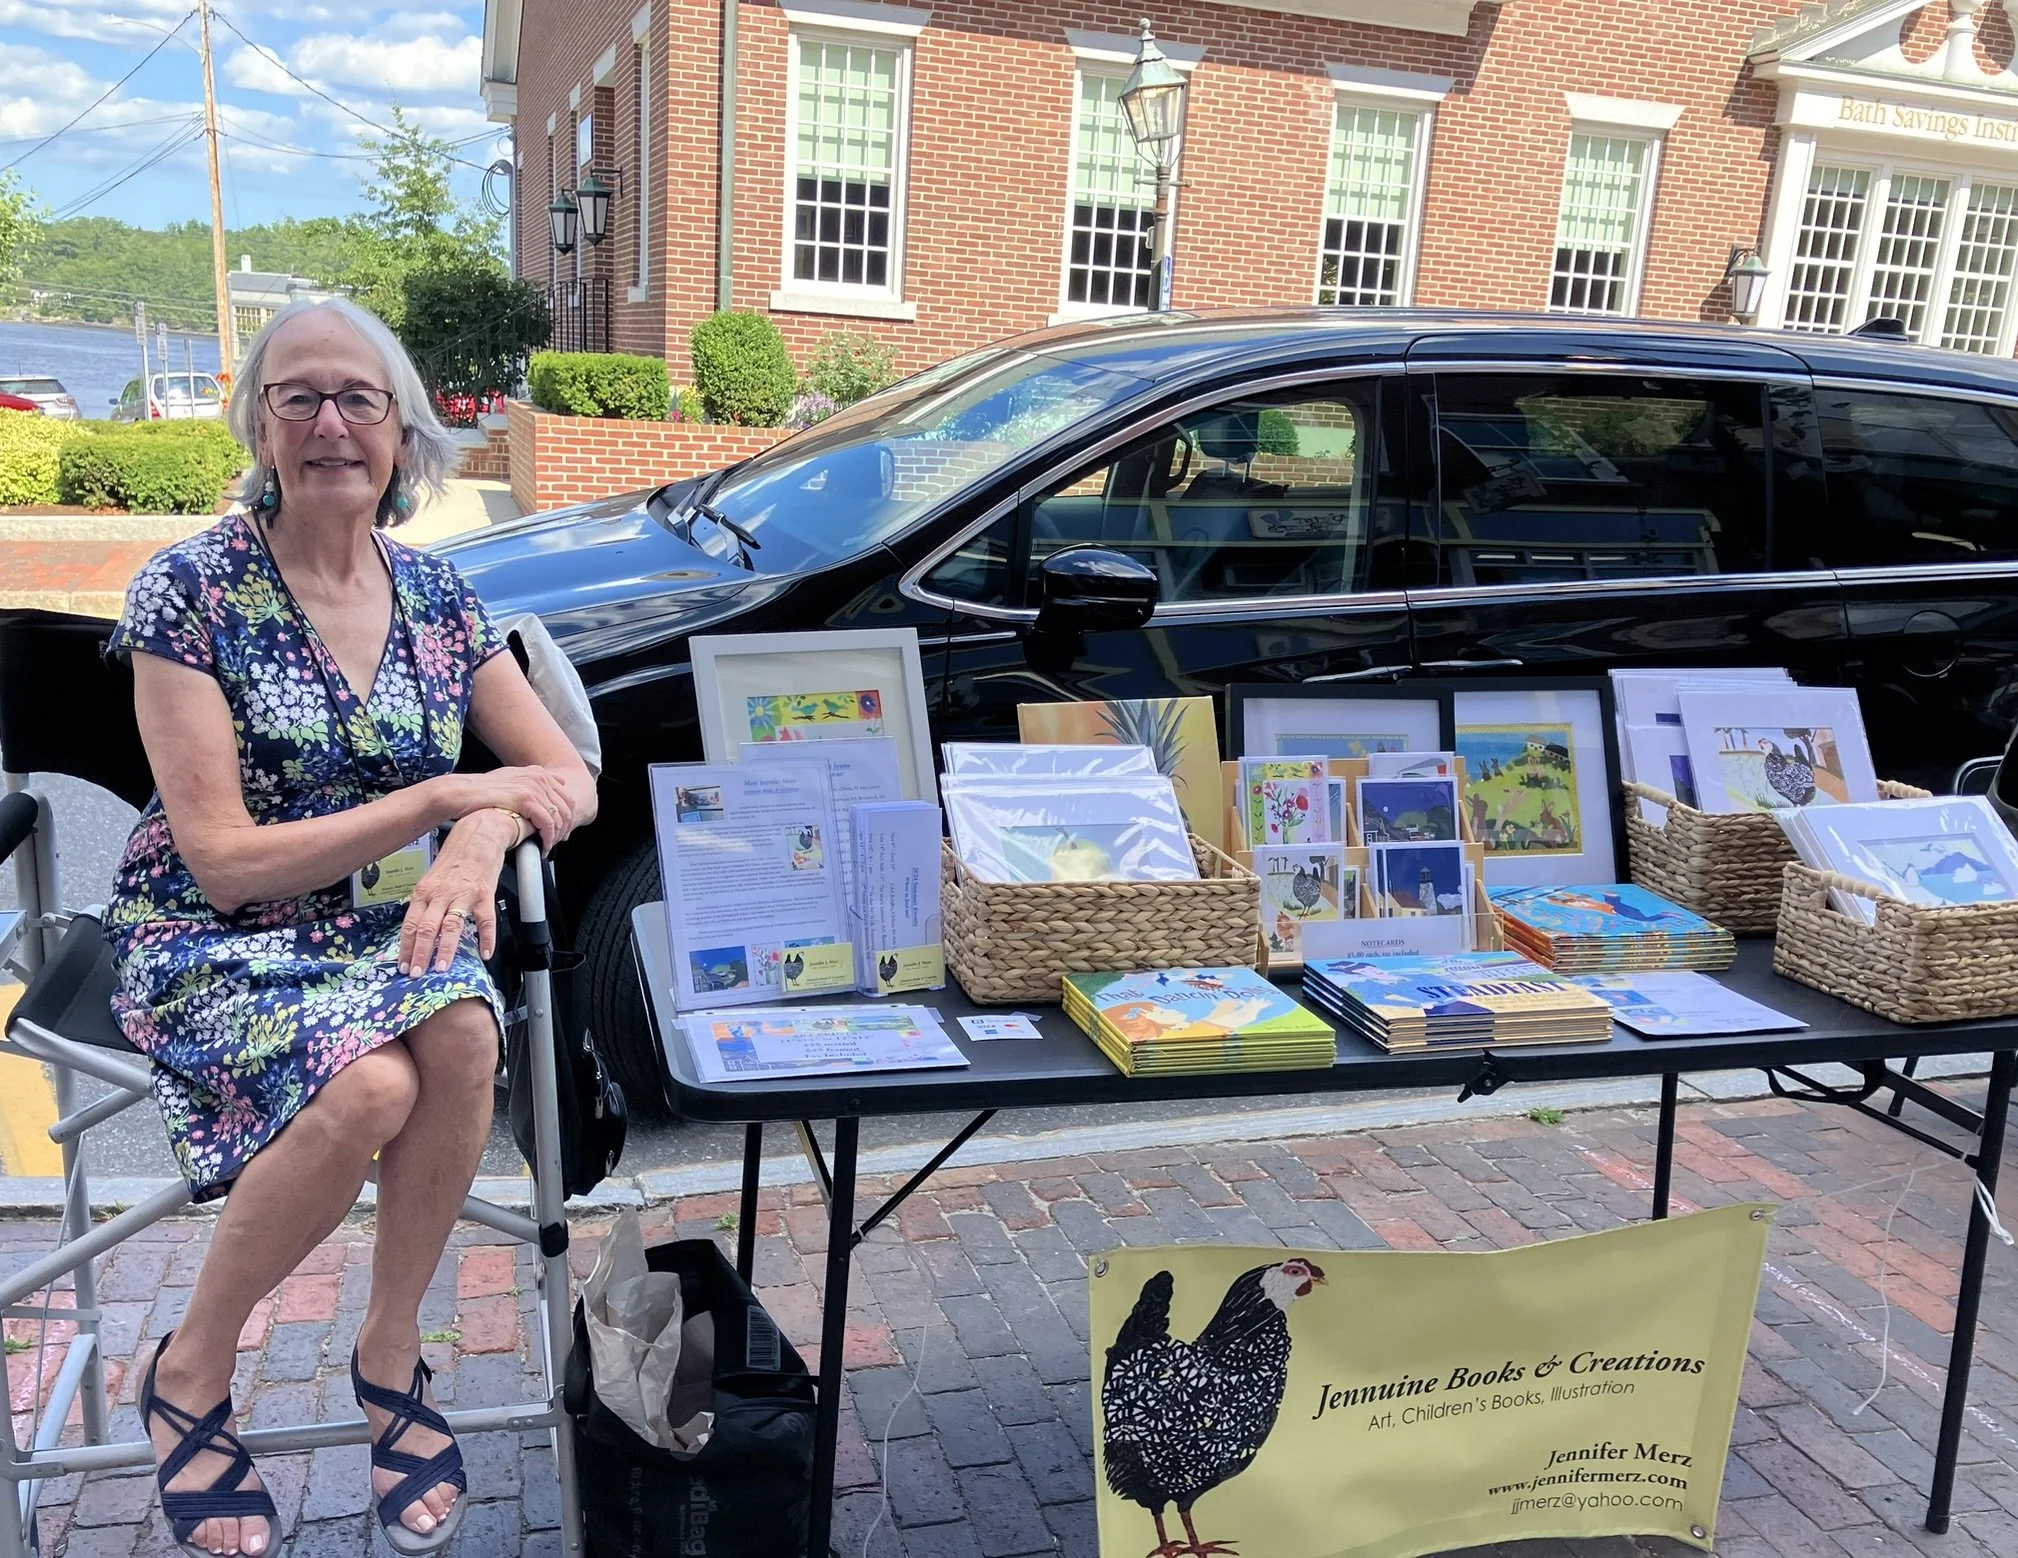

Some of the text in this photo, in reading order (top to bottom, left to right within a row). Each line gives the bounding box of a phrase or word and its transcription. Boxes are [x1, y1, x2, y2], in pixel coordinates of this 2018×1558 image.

[1837, 95, 1887, 125] Bath
[1892, 102, 1970, 141] Savings
[1361, 939, 1405, 947] NOTECARDS
[1392, 948, 1420, 956] included
[1098, 988, 1146, 1003] That
[1416, 980, 1567, 999] STEADFAST
[1312, 1350, 1706, 1420] Jennuine Books & Creations
[1368, 1380, 1635, 1431] Art, Children's Books, Illustration
[1543, 1441, 1693, 1470] Jennifer Merz
[1488, 1467, 1688, 1496] www.jennifermerz.com
[1510, 1491, 1684, 1516] jjmerz@yahoo.com
